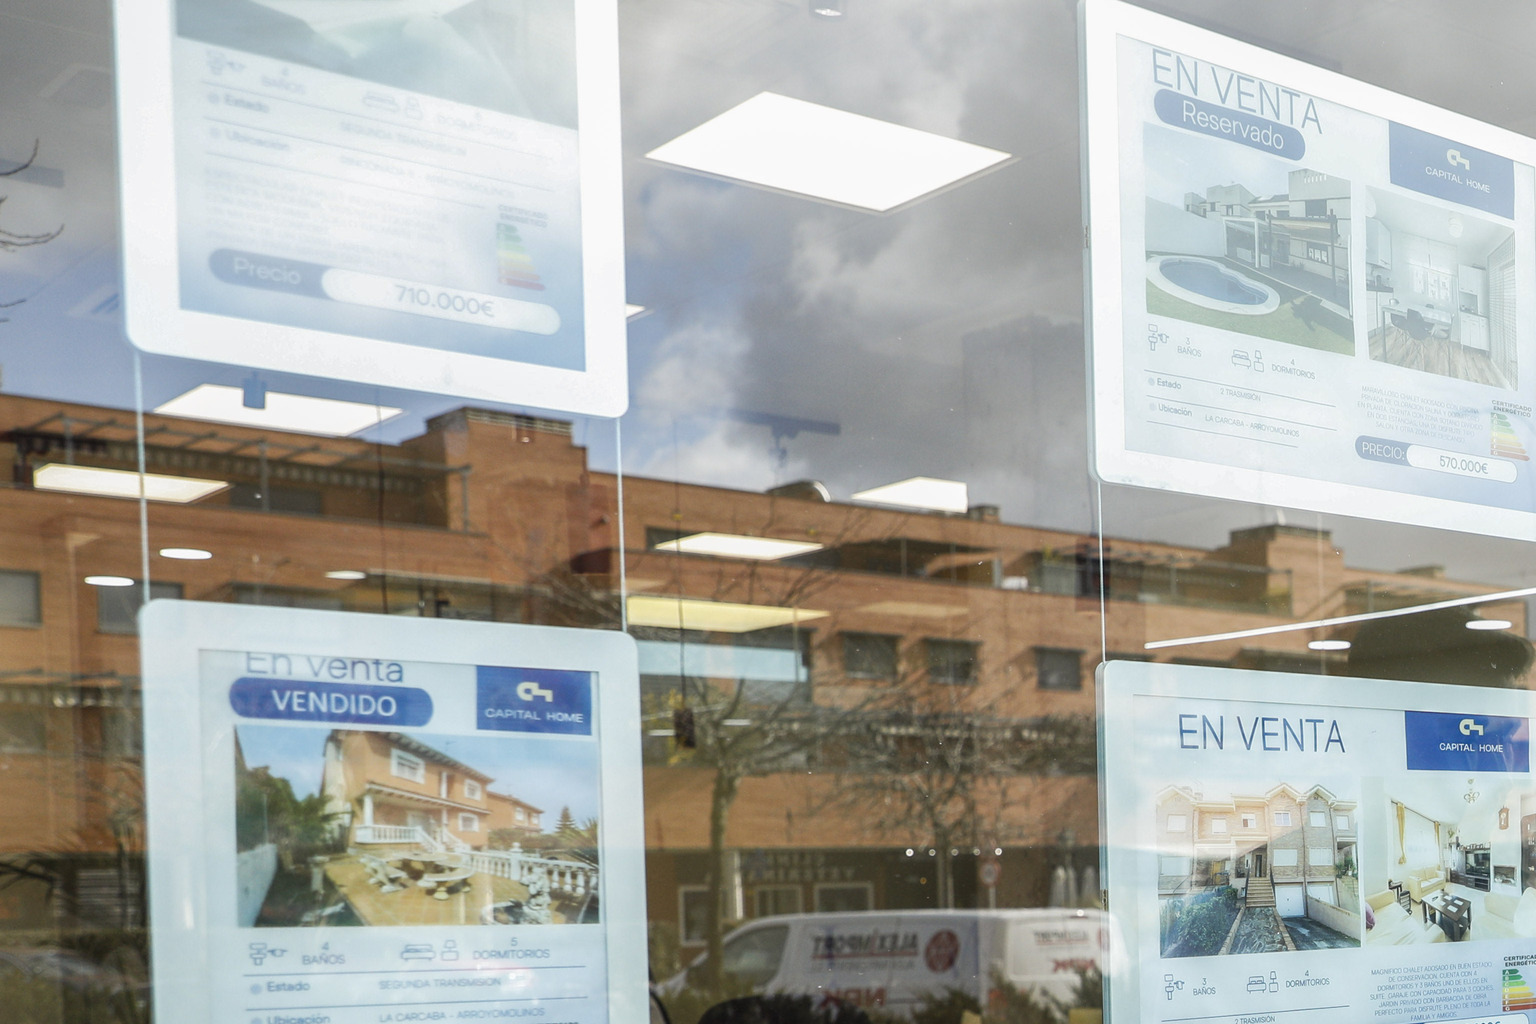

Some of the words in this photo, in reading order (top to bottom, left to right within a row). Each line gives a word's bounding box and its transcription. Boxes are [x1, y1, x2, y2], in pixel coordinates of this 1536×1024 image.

[1152, 48, 1199, 97] EN
[1211, 66, 1323, 135] VENTA
[1182, 101, 1285, 151] Reservado
[1425, 166, 1464, 185] CAPITAL
[1466, 177, 1491, 194] HOME
[233, 257, 301, 285] Precio
[394, 284, 496, 318] 710.000€
[1177, 345, 1202, 358] BAÑOS
[1271, 364, 1316, 380] DORMITORIOS
[1156, 377, 1182, 390] Estado
[1158, 403, 1193, 417] Ubicación
[1491, 399, 1532, 413] CERTIFICADO
[1493, 405, 1531, 418] ENERGÉTICO
[1362, 441, 1405, 461] PRECIO:
[1439, 455, 1489, 475] 570.000€
[247, 651, 293, 676] En
[307, 656, 404, 683] venta
[271, 689, 397, 717] VENDIDO
[485, 707, 541, 722] CAPITAL
[546, 711, 584, 724] HOME
[1178, 713, 1224, 750] EN
[1236, 715, 1346, 753] VENTA
[1439, 742, 1475, 753] CAPITAL
[1479, 744, 1504, 753] HOME
[302, 951, 346, 966] BAÑOS
[472, 947, 551, 961] DORMITORIOS
[266, 980, 311, 993] Estado
[1286, 978, 1330, 988] DORMITORIOS
[1193, 986, 1216, 995] BAÑOS
[1240, 1015, 1276, 1024] TRASMISIÓN
